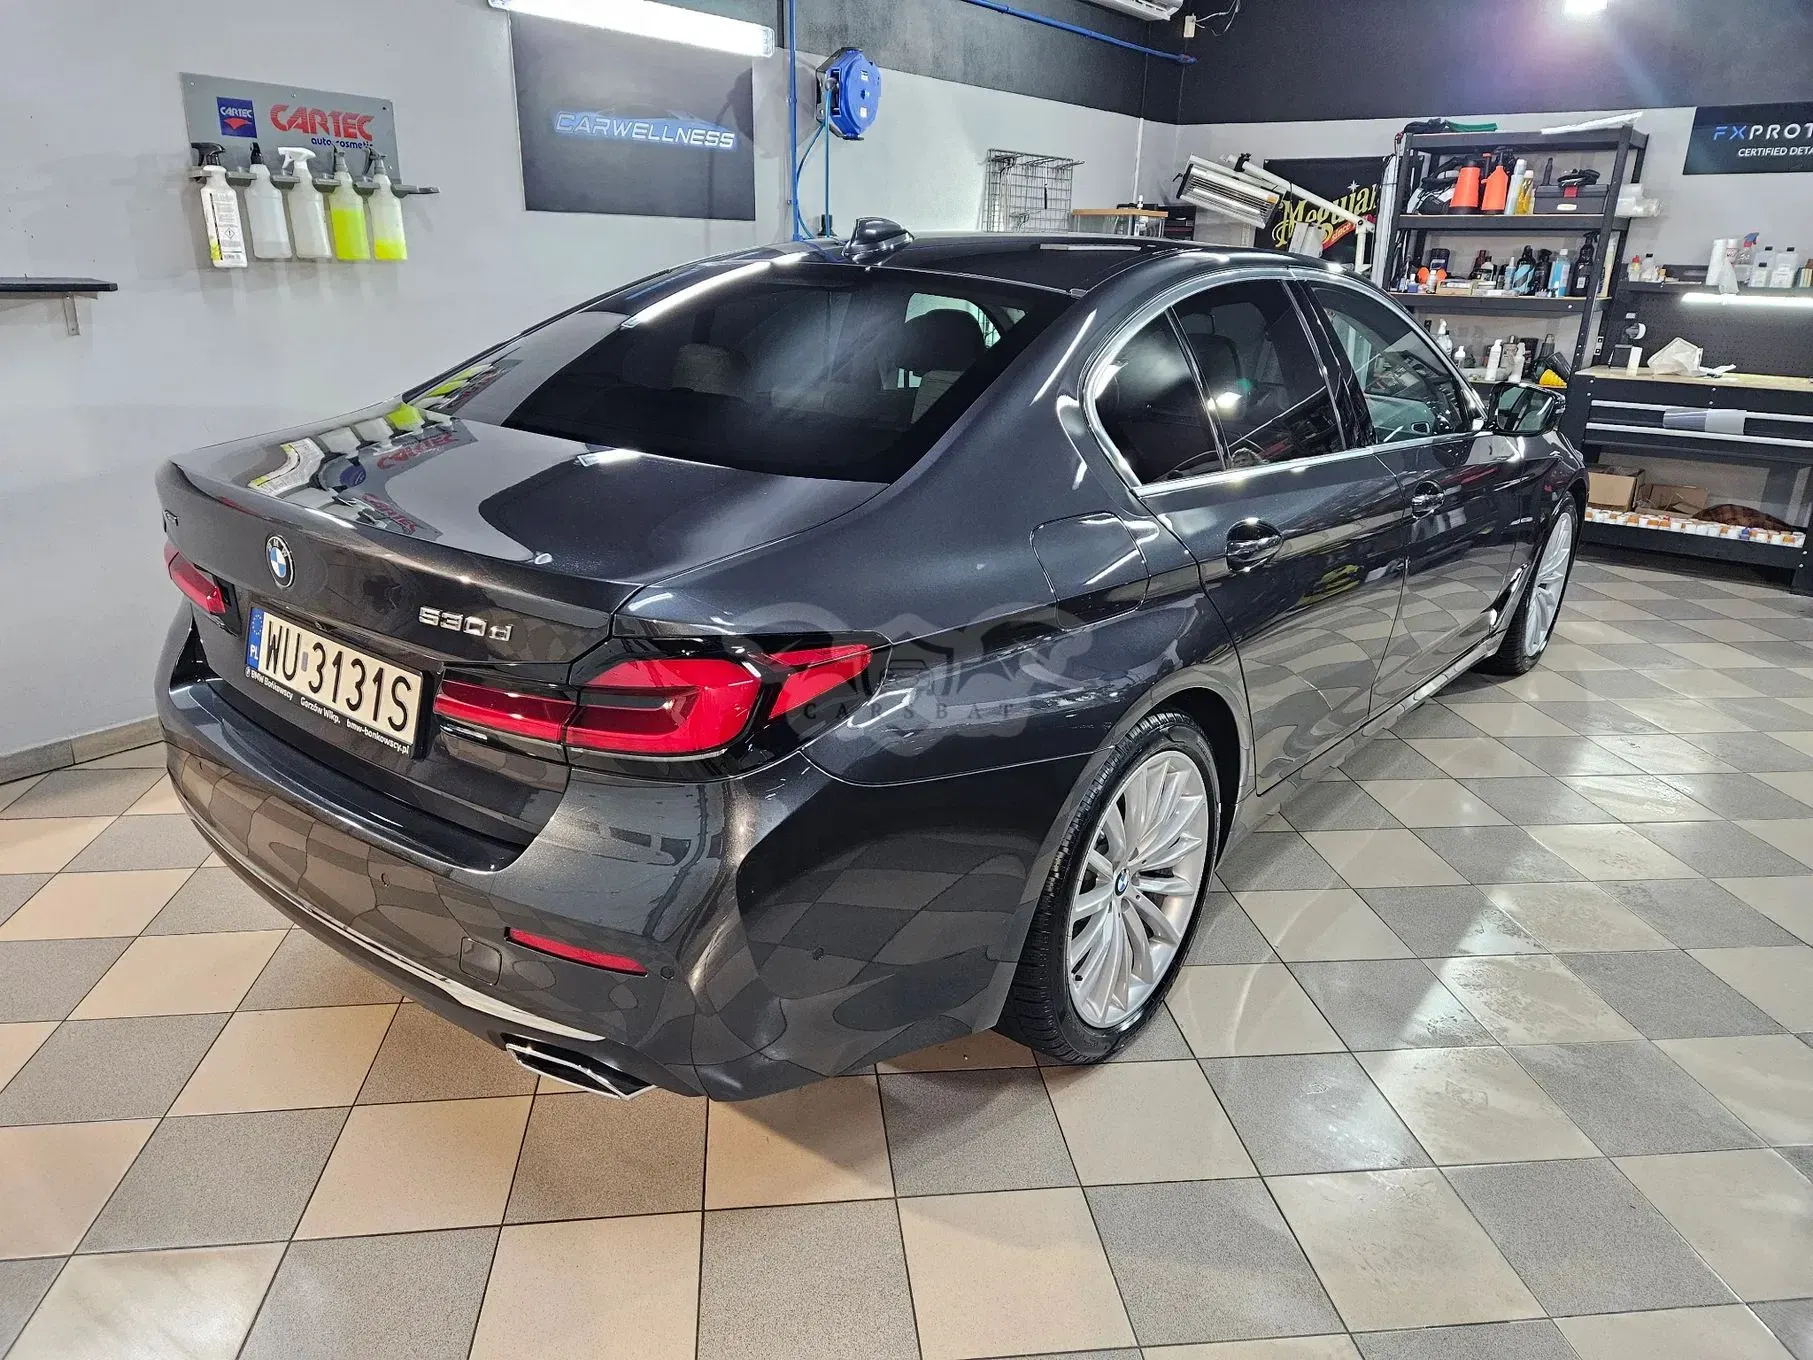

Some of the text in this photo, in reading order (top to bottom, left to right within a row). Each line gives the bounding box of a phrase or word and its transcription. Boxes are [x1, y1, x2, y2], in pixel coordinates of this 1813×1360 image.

[220, 106, 252, 117] CARTEC
[270, 104, 375, 141] CARTEC
[556, 113, 736, 148] CARWELLNESS
[311, 137, 332, 146] auto
[1738, 147, 1788, 157] CERTIFIED
[419, 606, 514, 642] 530d
[250, 644, 259, 661] PL
